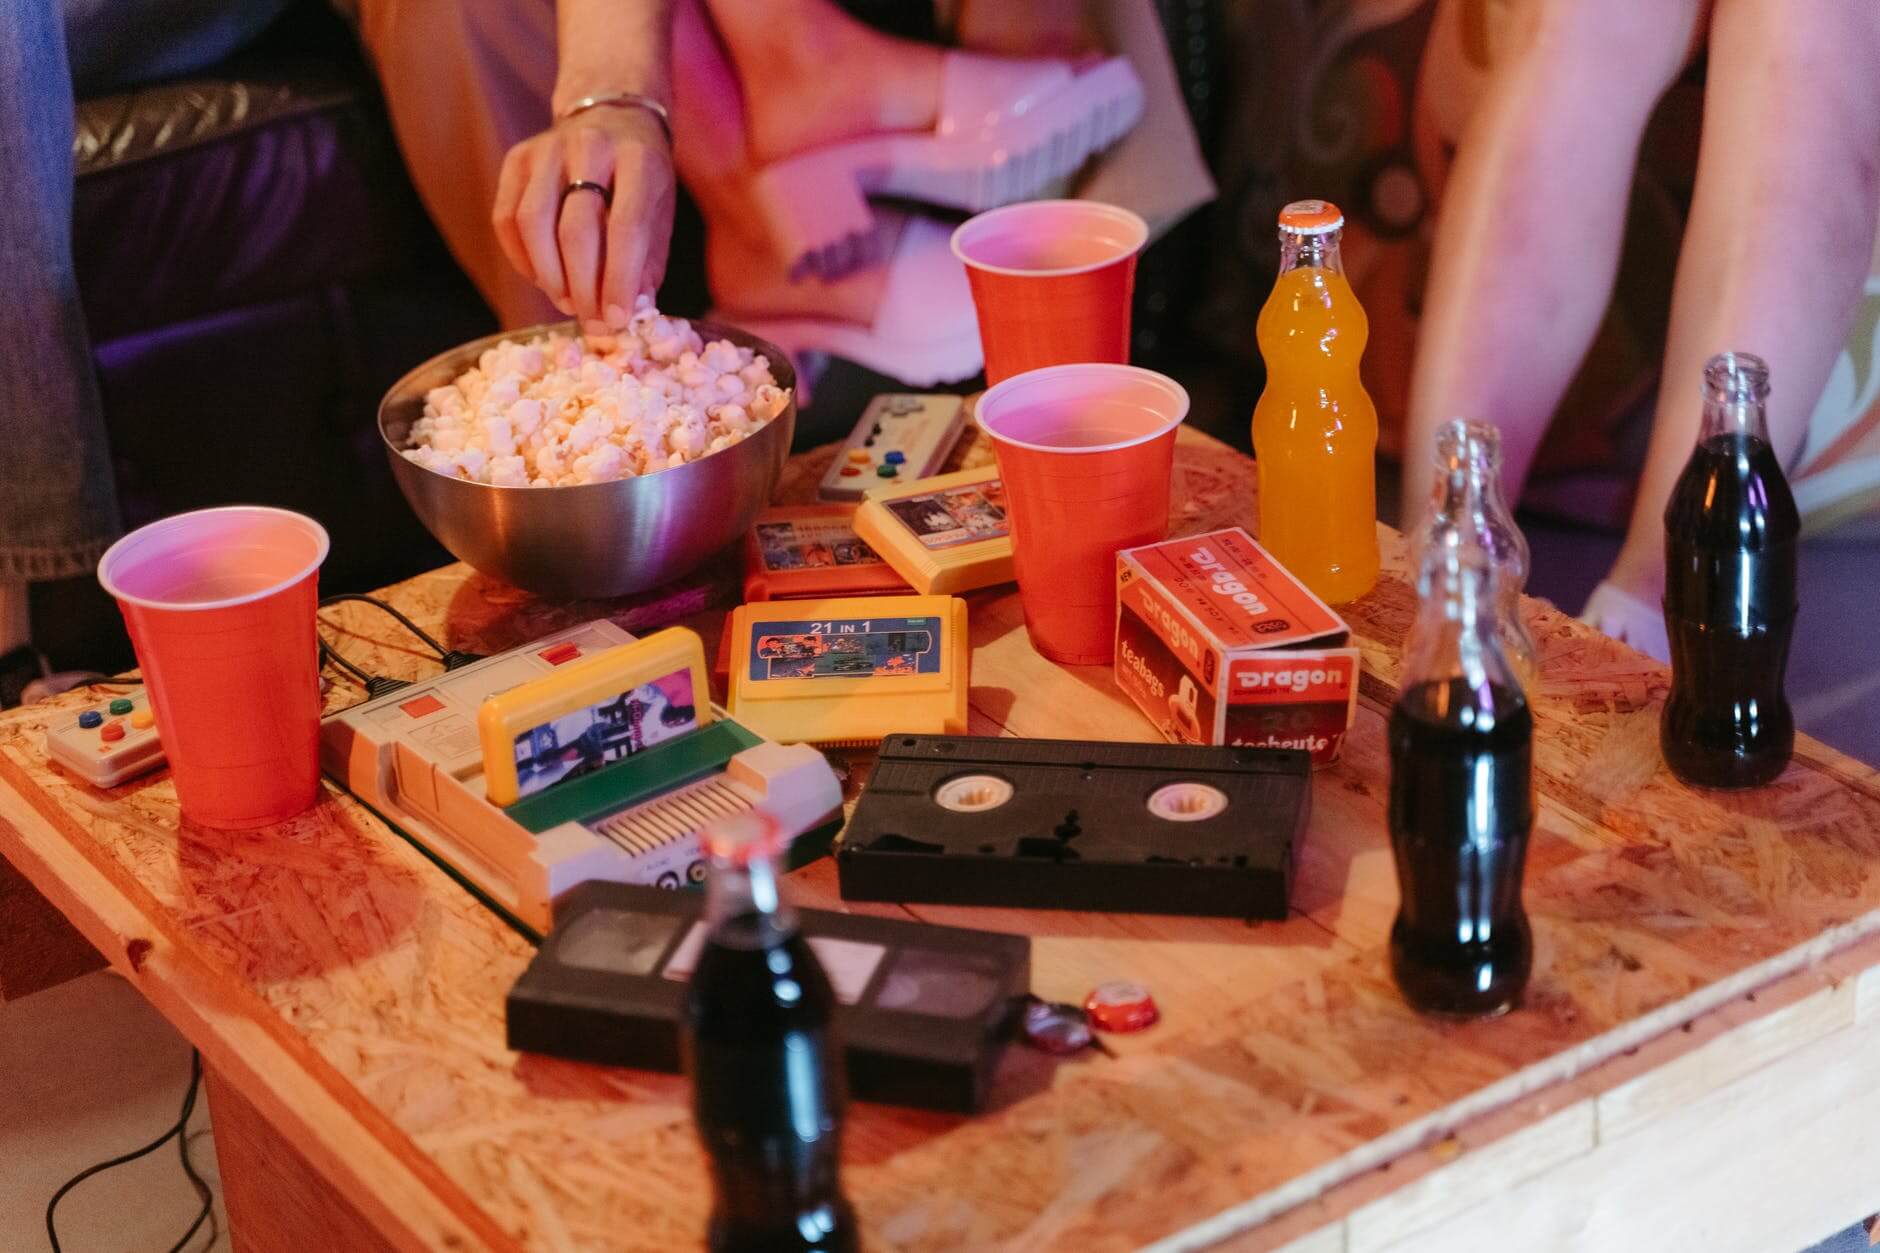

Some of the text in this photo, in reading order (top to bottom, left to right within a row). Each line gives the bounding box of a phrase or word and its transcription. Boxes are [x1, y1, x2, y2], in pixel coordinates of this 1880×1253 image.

[1189, 546, 1269, 616] Dragon
[810, 621, 871, 634] 21 IN 1
[1138, 587, 1200, 659] Dragon
[1121, 639, 1165, 698] teabags
[1236, 670, 1343, 692] Dragon
